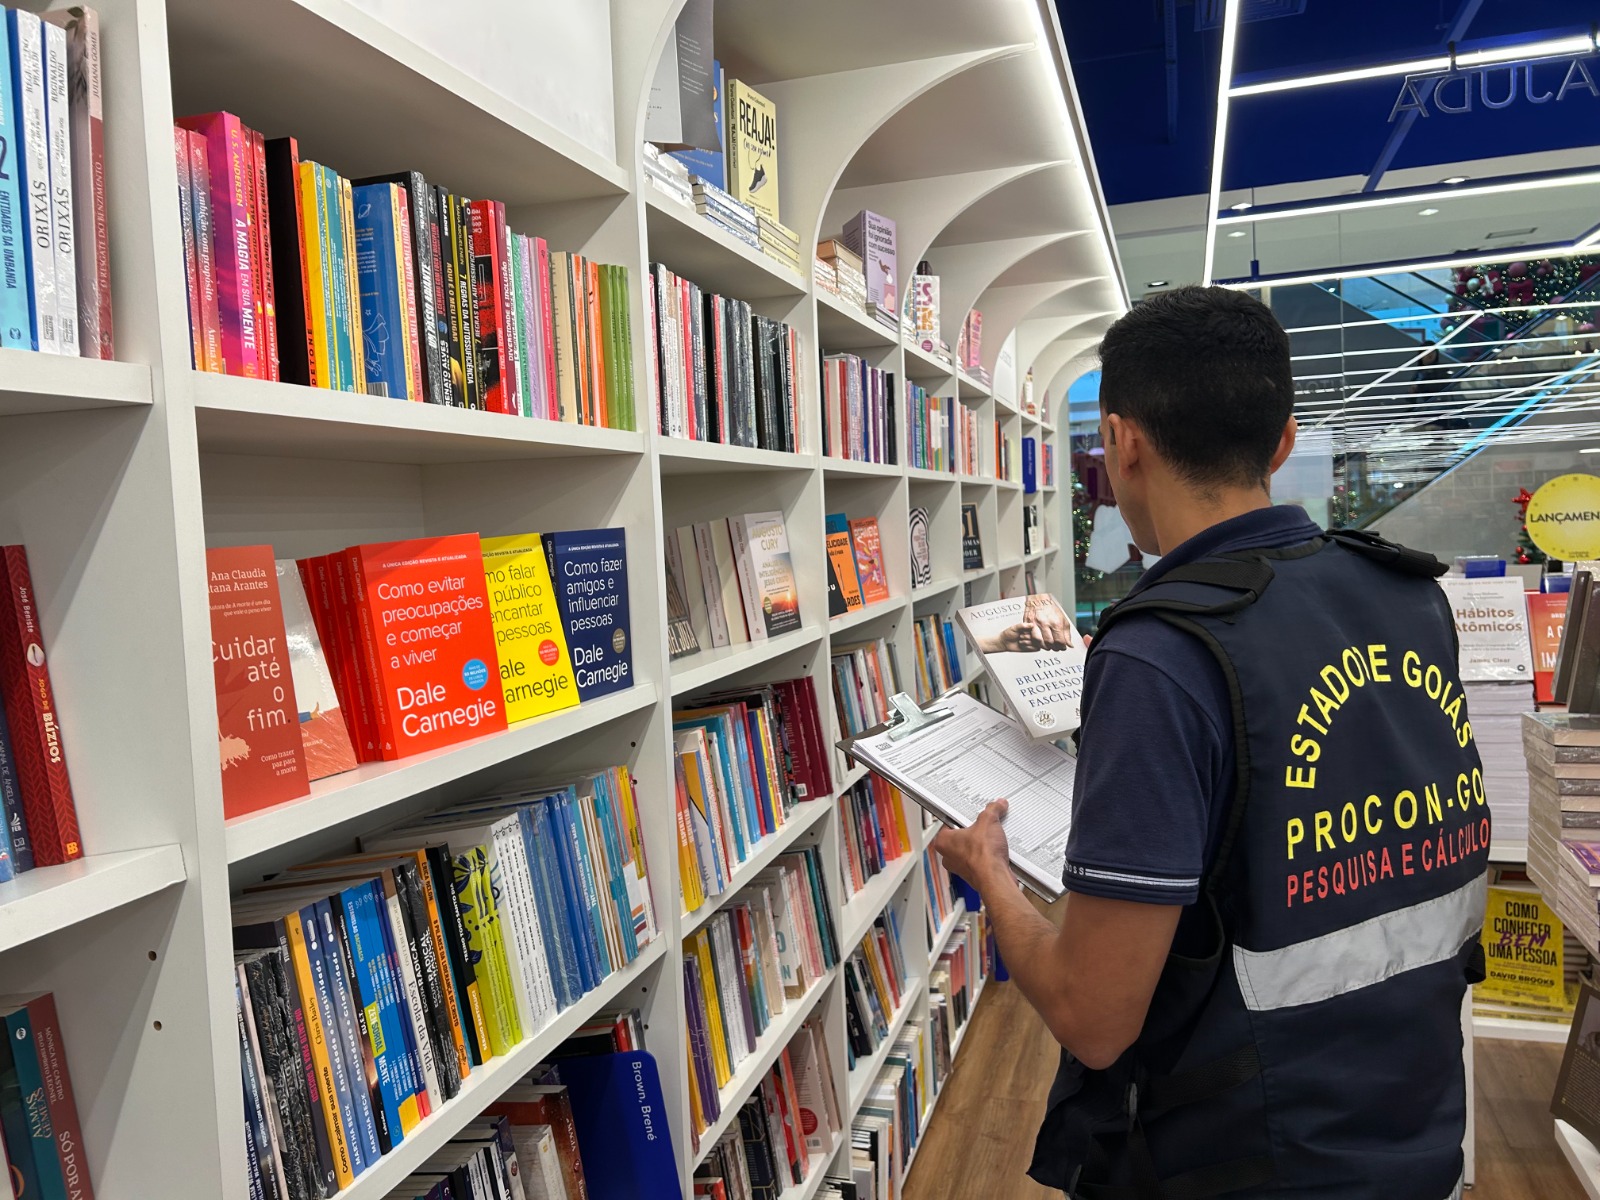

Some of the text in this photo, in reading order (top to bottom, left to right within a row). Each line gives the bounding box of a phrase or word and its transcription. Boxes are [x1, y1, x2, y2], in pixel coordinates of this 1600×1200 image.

[89, 31, 101, 98] JULIANA GOMES
[739, 98, 775, 150] REAJA!
[93, 160, 105, 218] BENZIMENTO
[232, 153, 245, 207] ANDERSEN
[30, 180, 50, 249] ORIXÁS
[53, 187, 72, 254] ORIXÁS
[1, 190, 16, 289] ENTIDADES UMBANDA
[197, 186, 214, 301] Ambição com propósito
[236, 230, 256, 350] MAGIA SUA MENTE
[501, 260, 510, 300] INCLUSÃO
[422, 262, 438, 348] UM PASSO ADIANTE
[446, 261, 458, 342] AQUI LUGAR
[208, 326, 218, 358] Amina
[459, 280, 474, 384] REGRAS AUTOSSUFICIÊNCIA
[505, 309, 515, 361] DIVERSIDADE
[307, 329, 317, 386] DETONE
[751, 525, 783, 539] AUGUSTO
[1530, 511, 1600, 525] LANÇAMEN
[512, 547, 533, 555] ATUALIZADA
[760, 538, 779, 551] CURY
[826, 537, 849, 549] ELICIDADE
[211, 567, 267, 582] Ana Claudia
[386, 554, 467, 568] ÚNICA EDIÇÃO REVISTA ATUALIZADA
[508, 564, 536, 581] falar
[564, 556, 623, 577] Como fazer
[207, 580, 269, 594] tana Arantes
[377, 574, 466, 601] Como evitar
[493, 583, 542, 606] público
[566, 578, 615, 597] amigos e
[19, 585, 34, 634] José Beniste
[381, 595, 484, 627] preocupações
[568, 593, 619, 614] influenciar
[970, 603, 1021, 621] AUGUSTO
[1456, 607, 1515, 619] Hábitos
[386, 620, 463, 646] e começar
[496, 620, 552, 647] pessoas
[570, 613, 613, 635] pessoas
[247, 656, 281, 682] até
[390, 646, 438, 669] a viver
[500, 658, 526, 680] ale
[574, 645, 604, 667] Dale
[1034, 656, 1061, 669] PAIS
[504, 673, 569, 704] arnegie
[576, 659, 628, 689] Carnegie
[1015, 664, 1084, 686] BRILHANTE
[273, 686, 284, 703] o
[396, 682, 447, 711] Dale
[37, 677, 61, 763] JOGO BÚZIOS
[401, 697, 497, 738] Carnegie
[1285, 646, 1366, 789] ESTADO
[1402, 650, 1474, 749] GOIÁS
[260, 748, 295, 763] Como trazer
[272, 757, 296, 770] paz para
[281, 764, 297, 775] morte
[1287, 816, 1489, 908] PESQUISA E CÁLCULO
[1505, 901, 1539, 920] COMO
[1494, 917, 1551, 940] CONHECER
[1499, 931, 1550, 949] BEM
[409, 937, 424, 986] RADICAL
[461, 938, 470, 963] TREINO
[1488, 942, 1513, 961] UMA
[1515, 946, 1558, 967] PESSOA
[433, 924, 460, 1028] PILARES LIDERANÇA CRISTO
[1490, 970, 1555, 987] DAVID BROOKS
[308, 995, 323, 1045] Chris Bailey
[315, 959, 347, 1092] Ansiedade Criatividade
[332, 950, 364, 1082] Ansiedade Criatividade
[408, 981, 434, 1073] Escola da Vida
[294, 1008, 319, 1102] UM SALTO PARA SUCESSO
[367, 1006, 384, 1052] ZENSORIAL
[378, 1055, 390, 1087] MENTE
[44, 1026, 65, 1101] MÔNICA CASTRO
[250, 1079, 263, 1109] INTELIGÊNCIA
[631, 1060, 656, 1142] Brown, Brené
[25, 1096, 43, 1138] ALMAS
[322, 1066, 349, 1174] Como acalmar sua mente
[359, 1092, 376, 1153] MARTHA BECK
[343, 1103, 361, 1165] MARTHA BECK
[58, 1130, 80, 1188] SÓ POR
